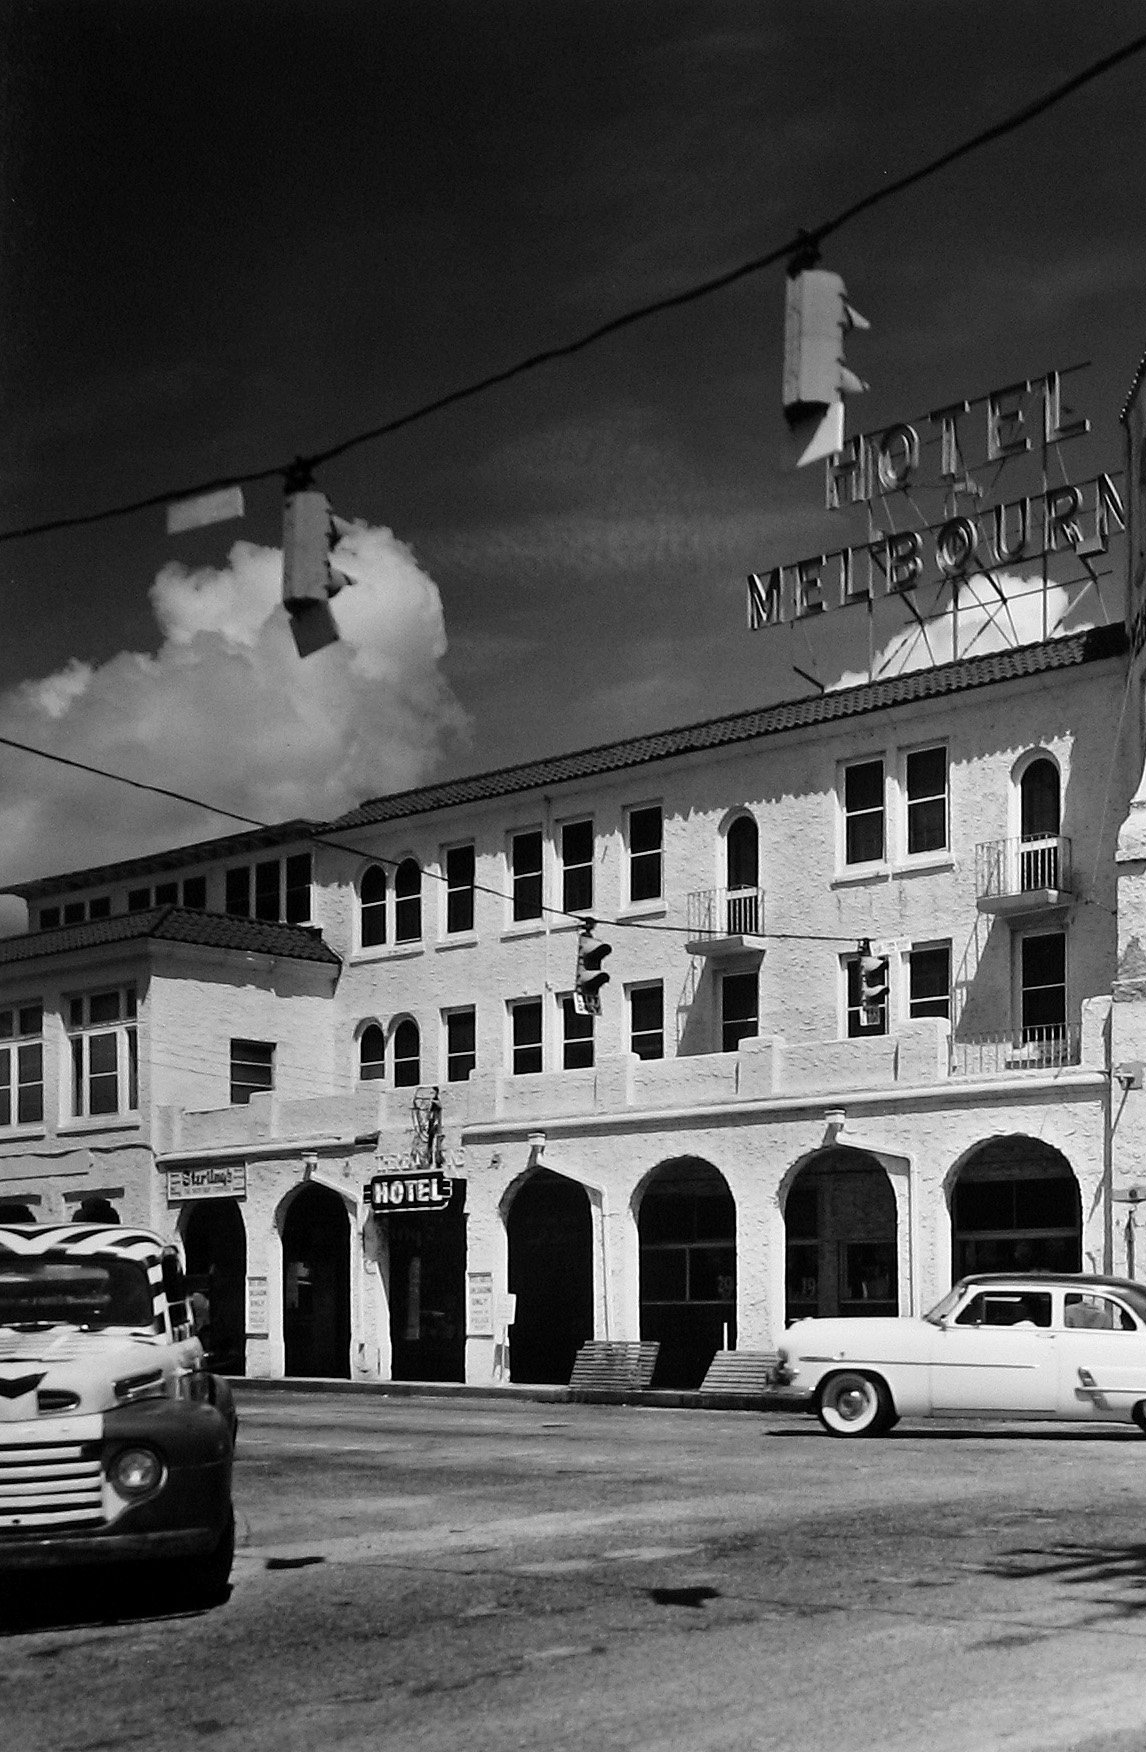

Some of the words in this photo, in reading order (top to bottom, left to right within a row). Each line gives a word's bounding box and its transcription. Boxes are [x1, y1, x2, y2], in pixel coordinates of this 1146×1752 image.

[825, 370, 1091, 510] HOTEL
[747, 472, 1125, 630] MELBOURN
[373, 1178, 443, 1204] HOTEL
